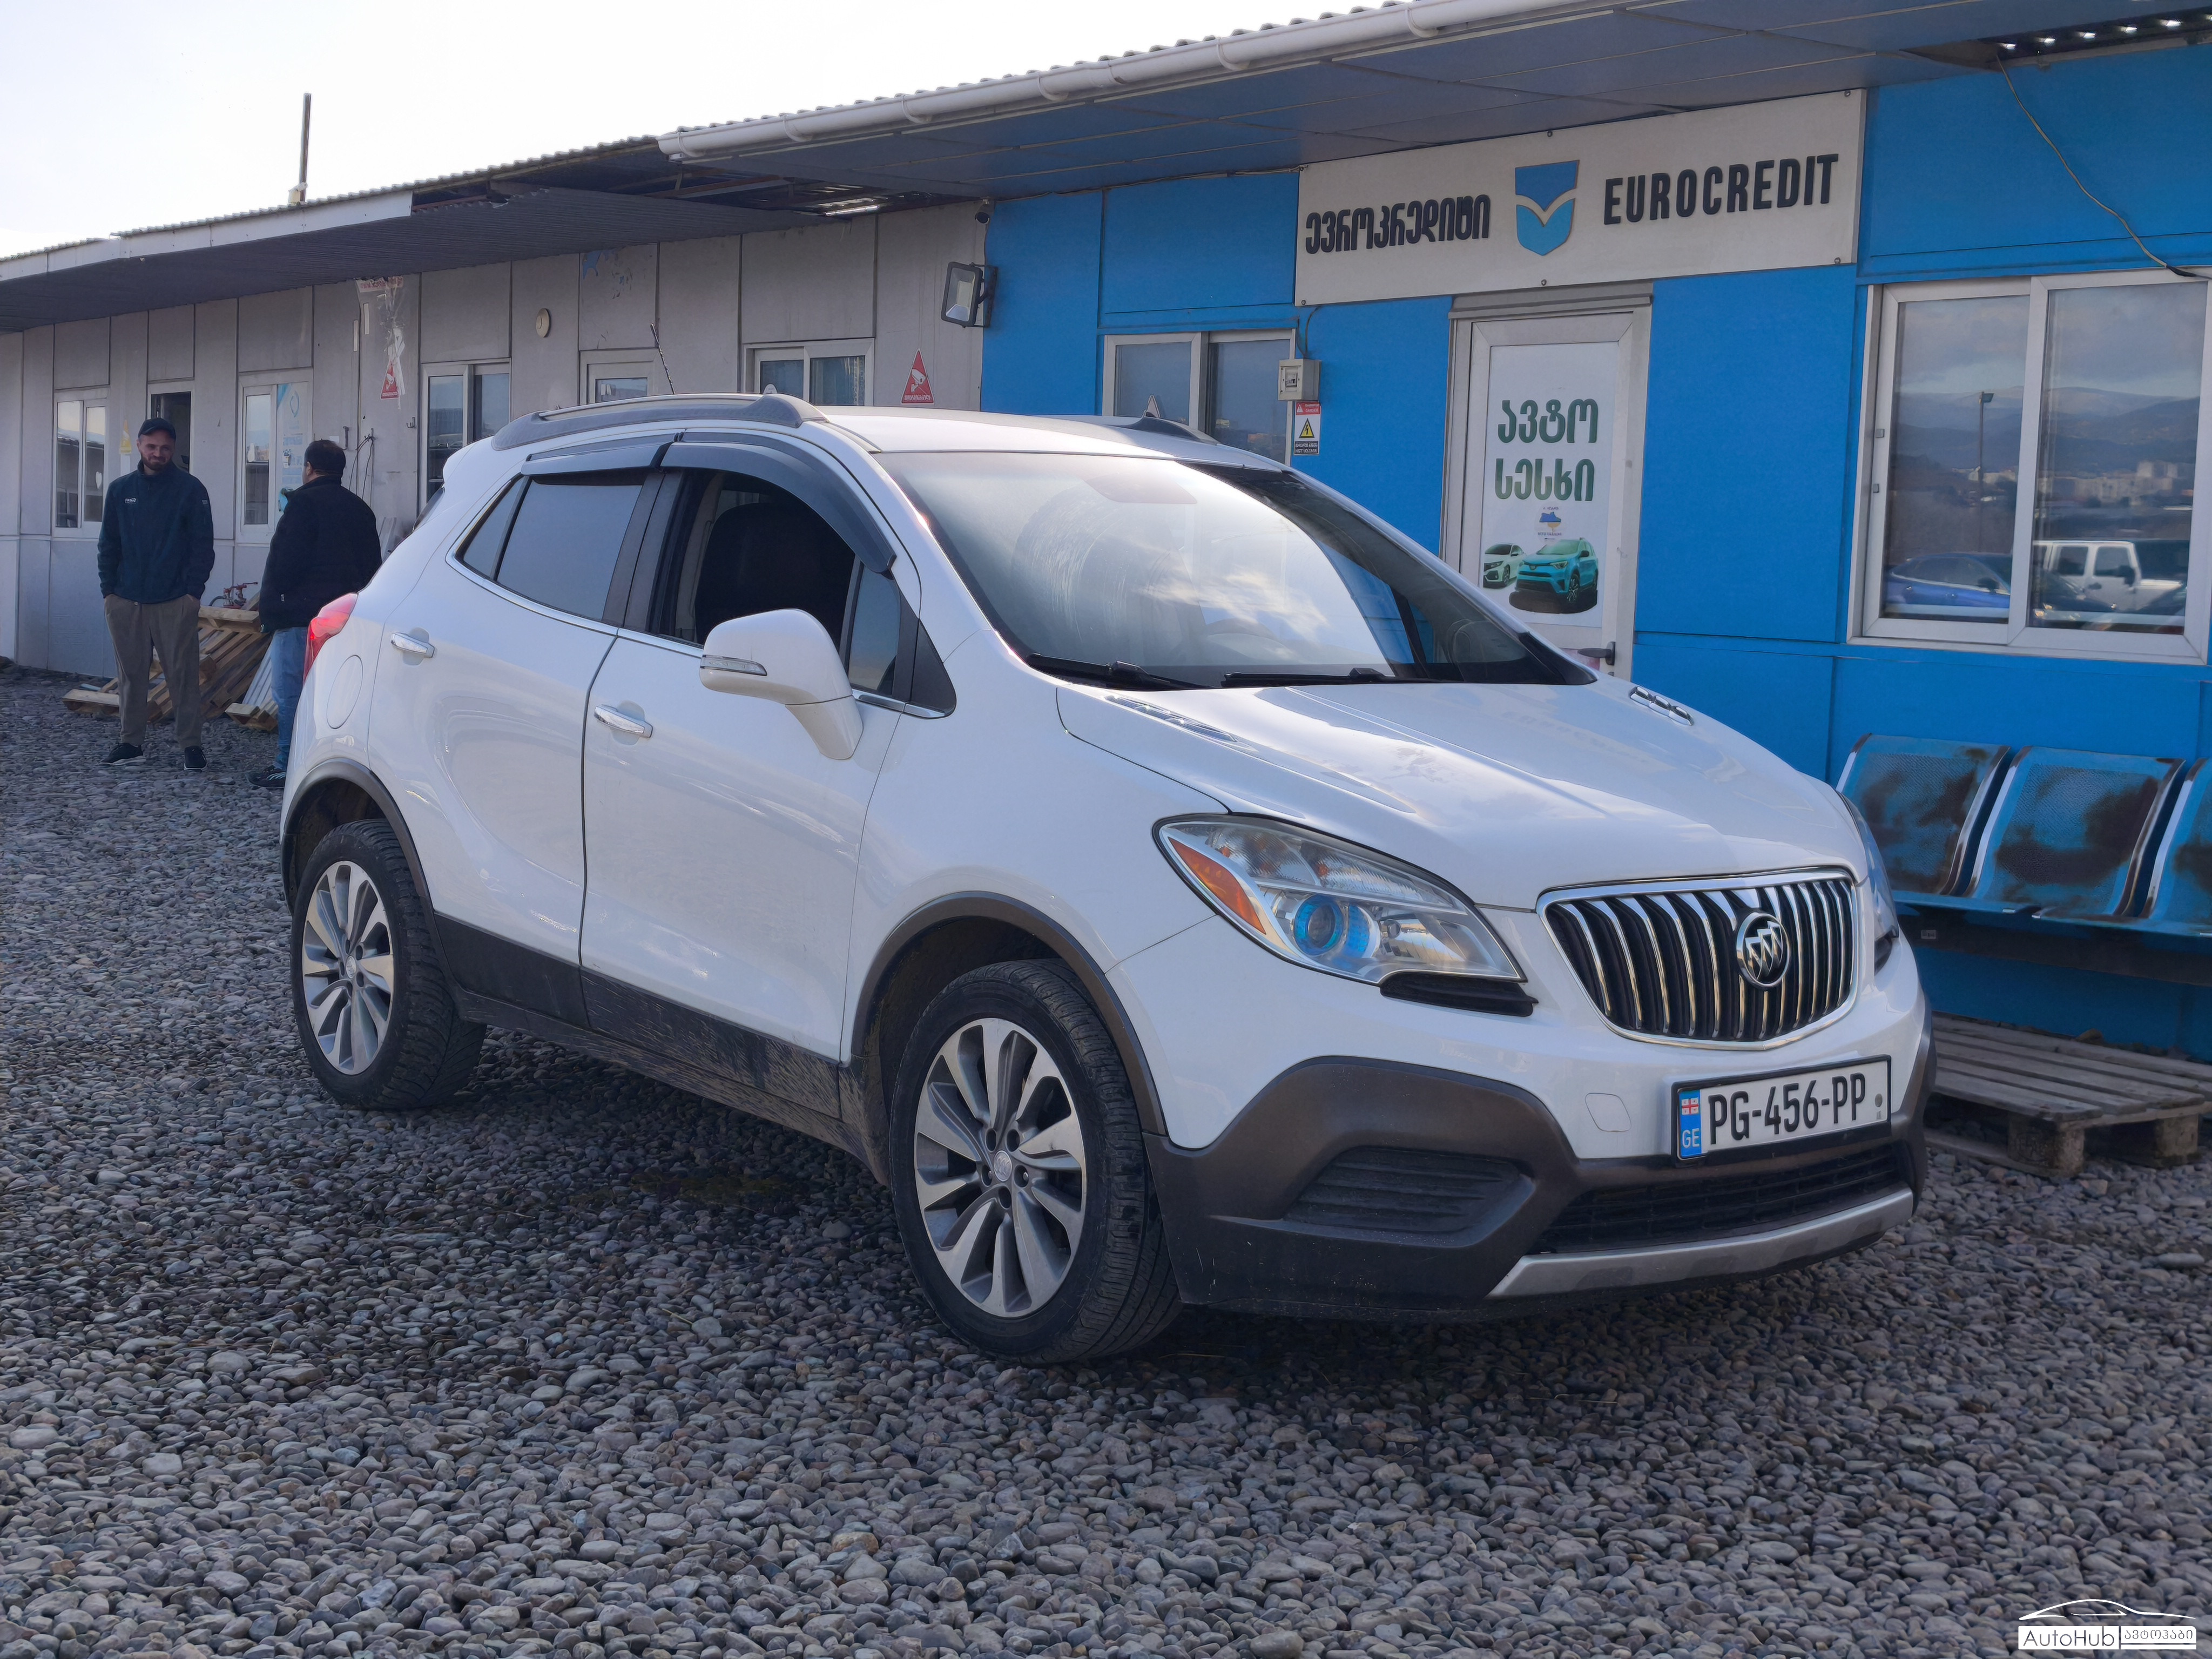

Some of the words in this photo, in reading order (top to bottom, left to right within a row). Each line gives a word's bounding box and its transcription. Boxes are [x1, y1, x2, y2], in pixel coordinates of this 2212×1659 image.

[1603, 153, 1839, 225] EUROCREDIT
[1305, 194, 1491, 254] ევროკრედიტი
[1498, 398, 1599, 443] ავტო
[1494, 458, 1595, 502] სესხი
[1708, 1072, 1866, 1145] PG-456-PP
[1682, 1128, 1700, 1148] GE
